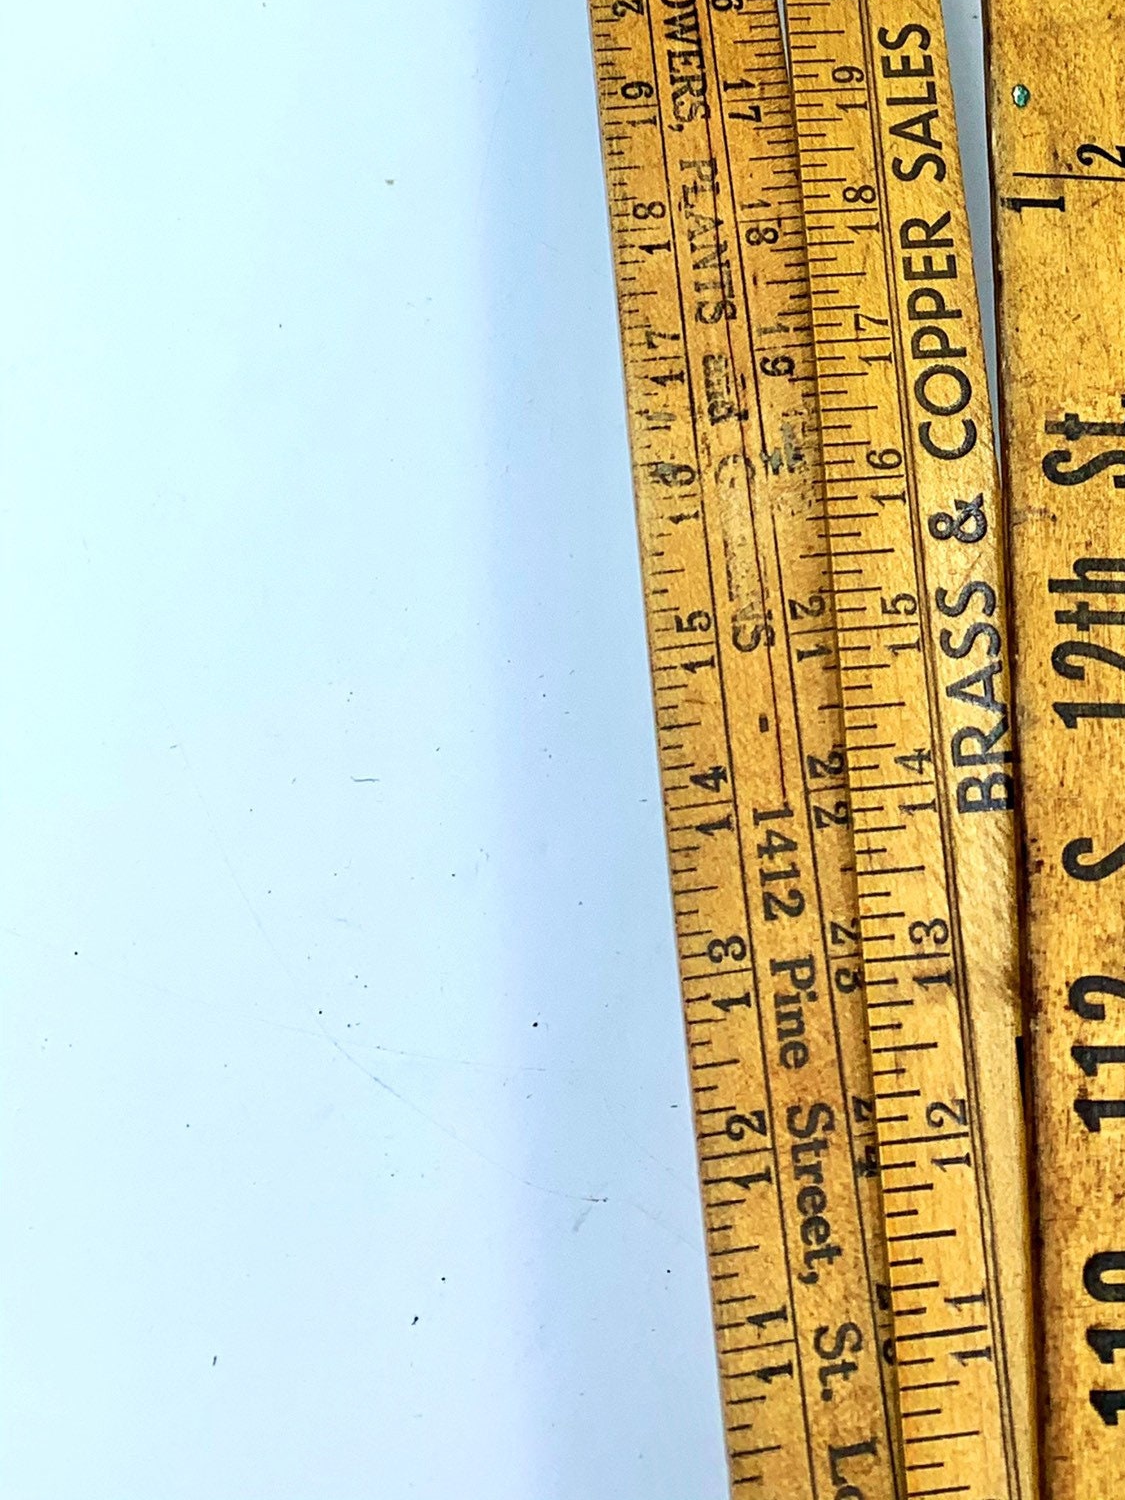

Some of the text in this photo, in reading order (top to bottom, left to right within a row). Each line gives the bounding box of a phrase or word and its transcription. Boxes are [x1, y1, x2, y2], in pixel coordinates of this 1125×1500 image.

[877, 23, 946, 182] SALES
[1001, 196, 1065, 213] 1
[900, 210, 977, 460] COPPER
[928, 492, 988, 544] &
[935, 581, 1015, 814] BRASS
[753, 802, 806, 922] 1412
[770, 954, 818, 1069] Pine
[786, 1102, 842, 1285] Street,
[813, 1322, 862, 1401] St.
